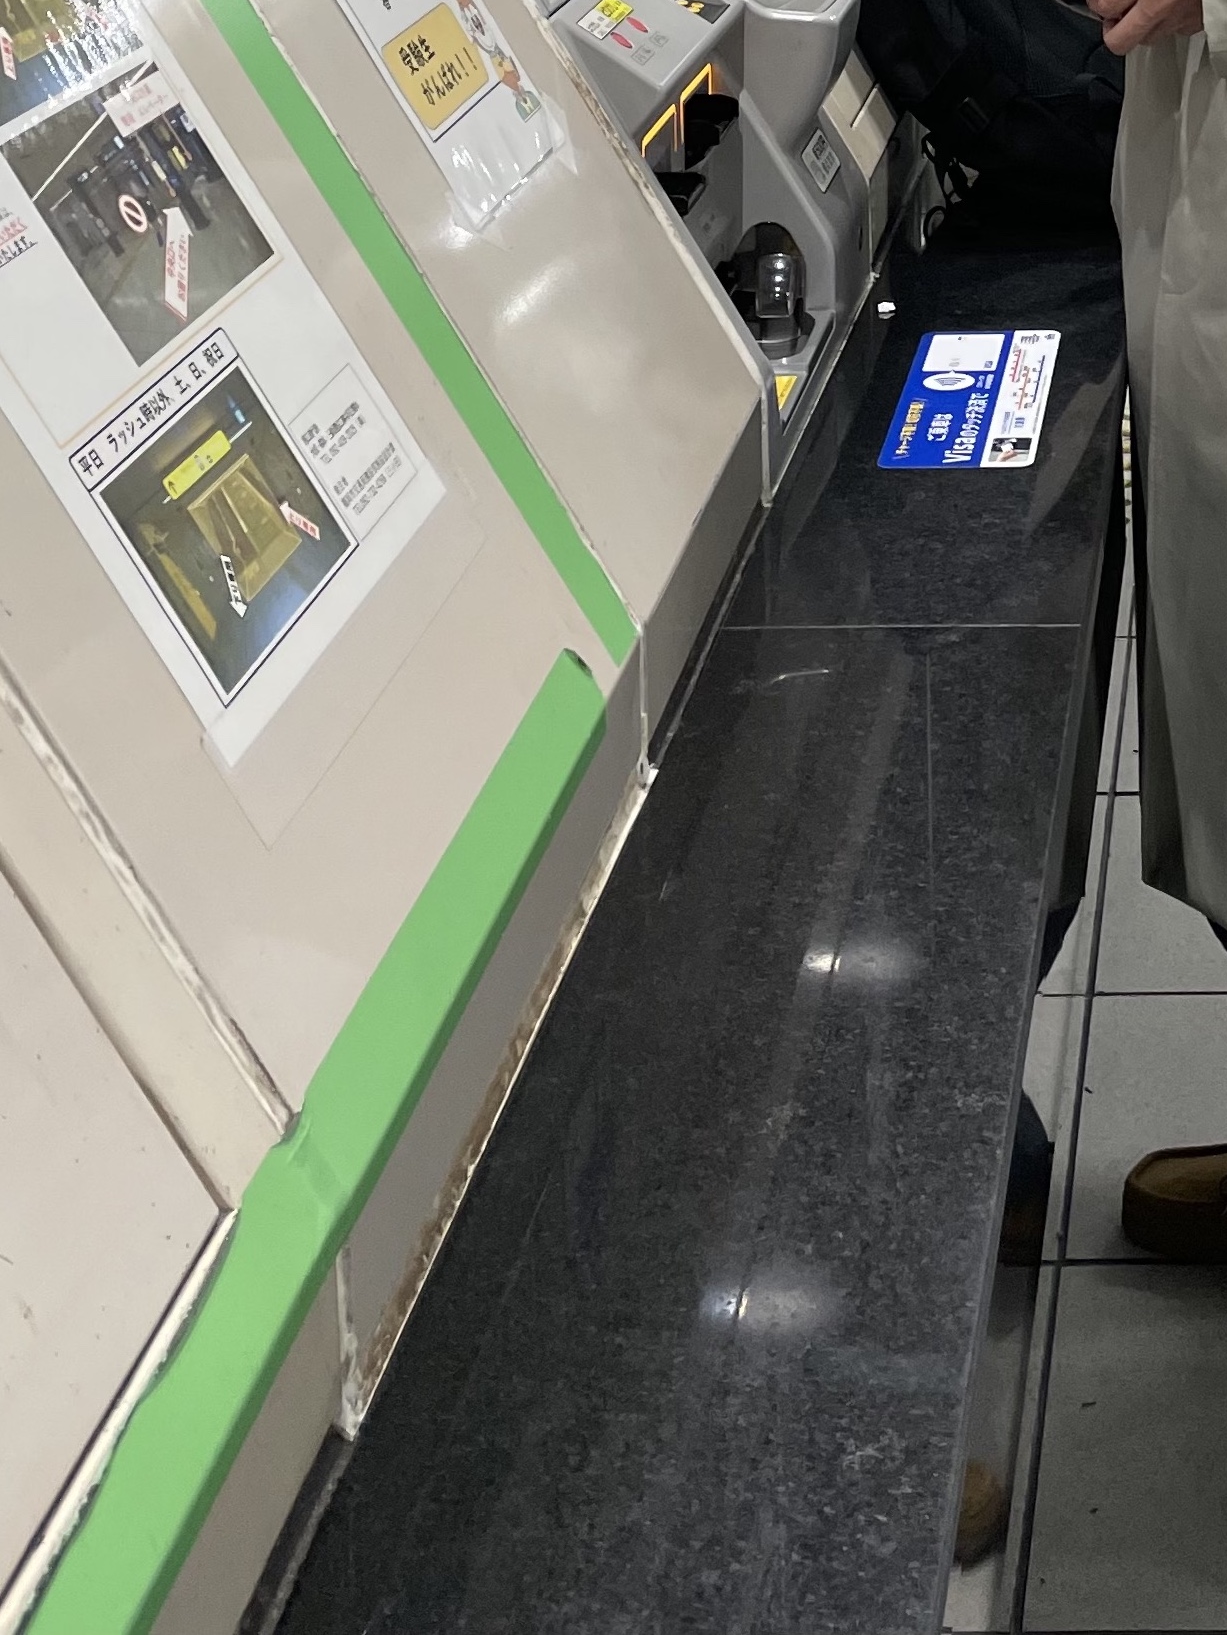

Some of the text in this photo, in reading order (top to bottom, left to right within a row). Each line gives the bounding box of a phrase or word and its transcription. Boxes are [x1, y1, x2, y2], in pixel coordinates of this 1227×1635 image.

[398, 34, 436, 76] 受験生
[78, 448, 105, 477] 平日
